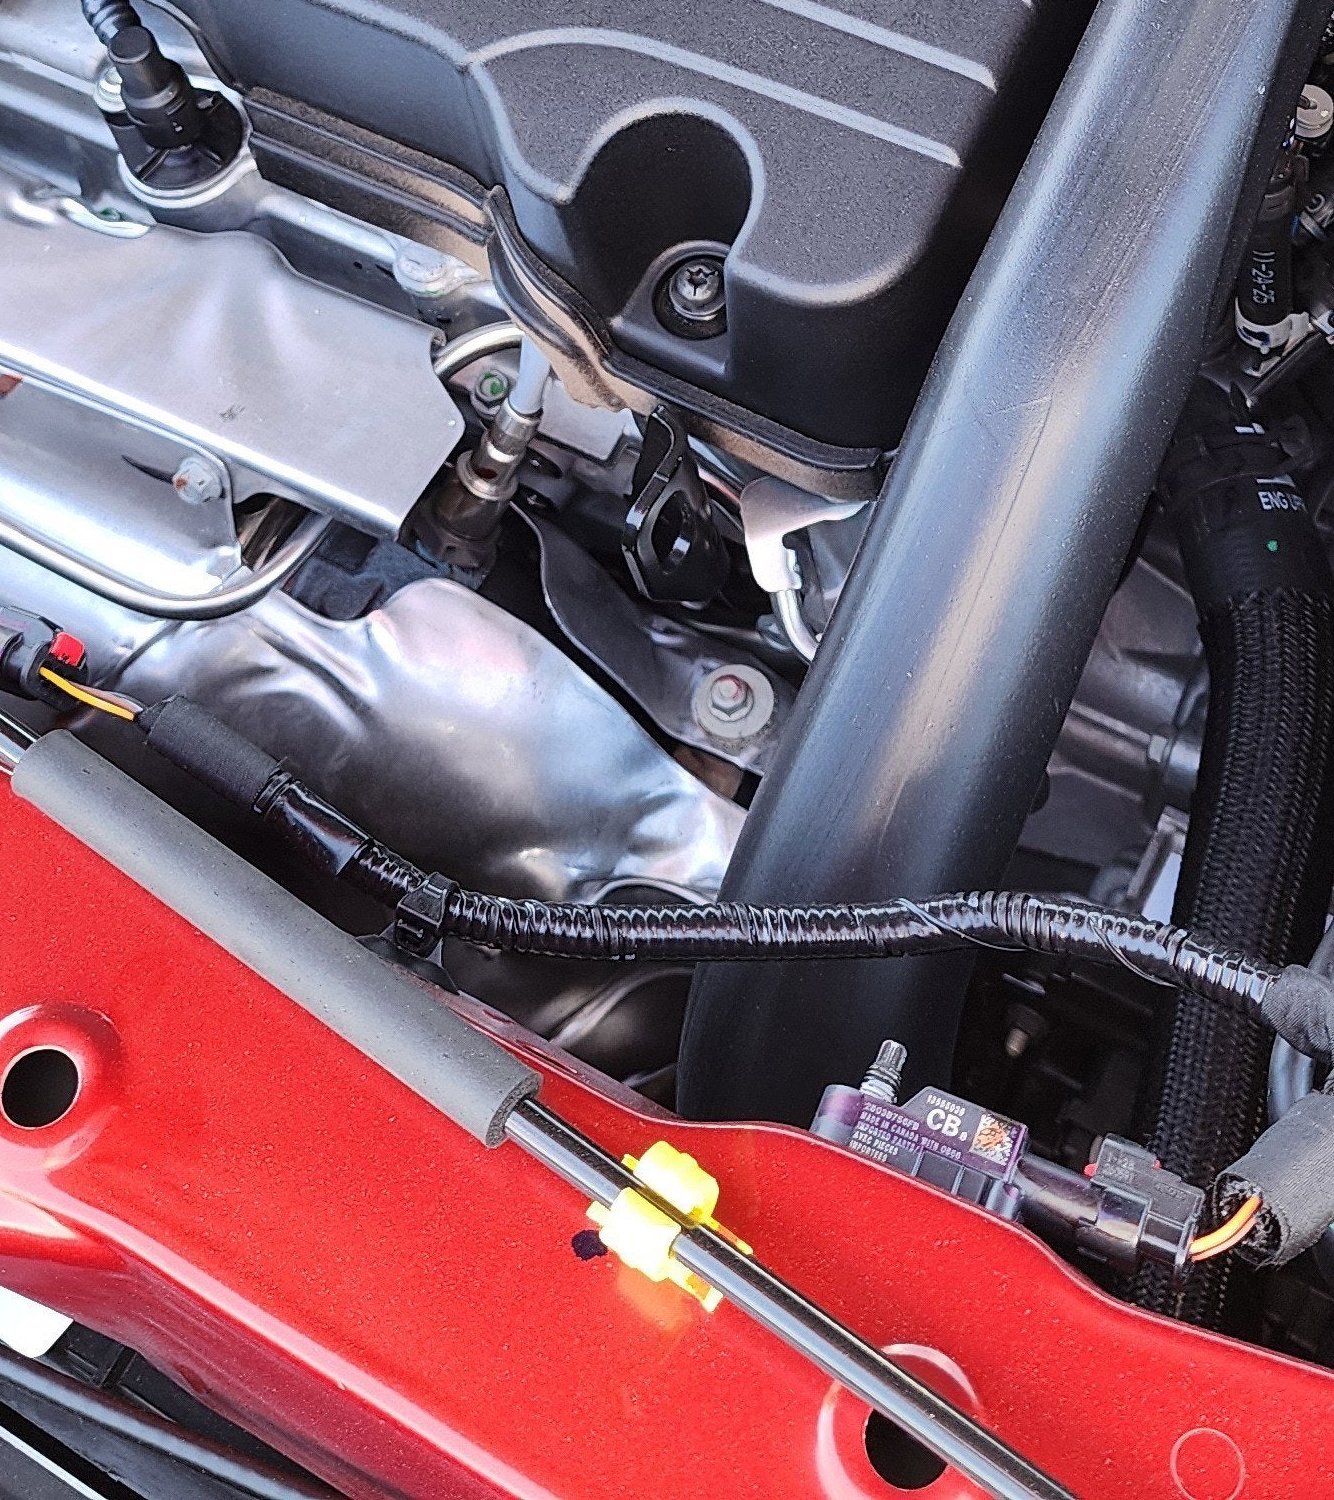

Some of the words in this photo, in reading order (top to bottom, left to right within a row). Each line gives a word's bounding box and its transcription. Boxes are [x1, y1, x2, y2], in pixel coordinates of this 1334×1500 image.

[857, 1119, 890, 1143] IMPORTED
[860, 1110, 879, 1128] MADE
[891, 1122, 919, 1143] CANADA
[920, 1134, 940, 1151] WITH
[926, 1108, 962, 1137] CB
